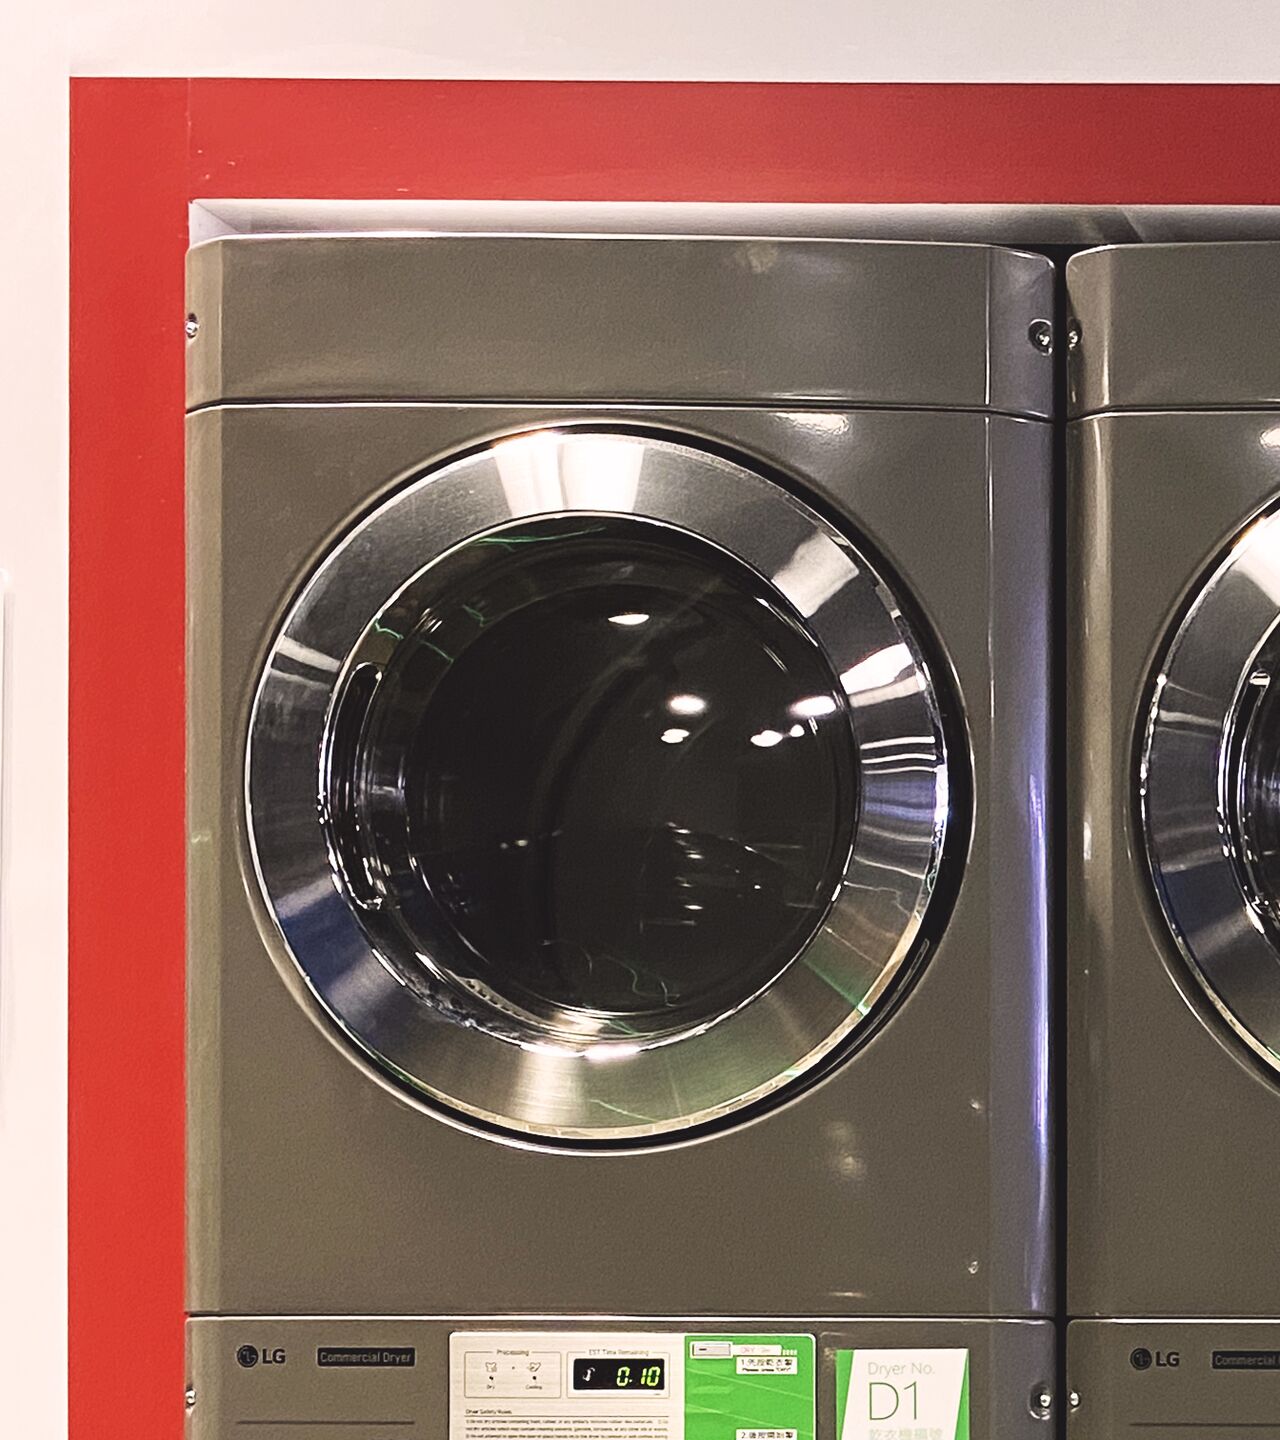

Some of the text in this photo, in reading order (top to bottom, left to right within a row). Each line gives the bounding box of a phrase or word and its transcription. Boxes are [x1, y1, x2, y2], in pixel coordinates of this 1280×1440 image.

[263, 1348, 285, 1364] LG
[321, 1352, 411, 1364] Commercial Dryer
[1156, 1352, 1179, 1367] LG
[1215, 1355, 1275, 1365] Commercial
[868, 1362, 935, 1377] Dryer No.
[870, 1382, 917, 1421] D1
